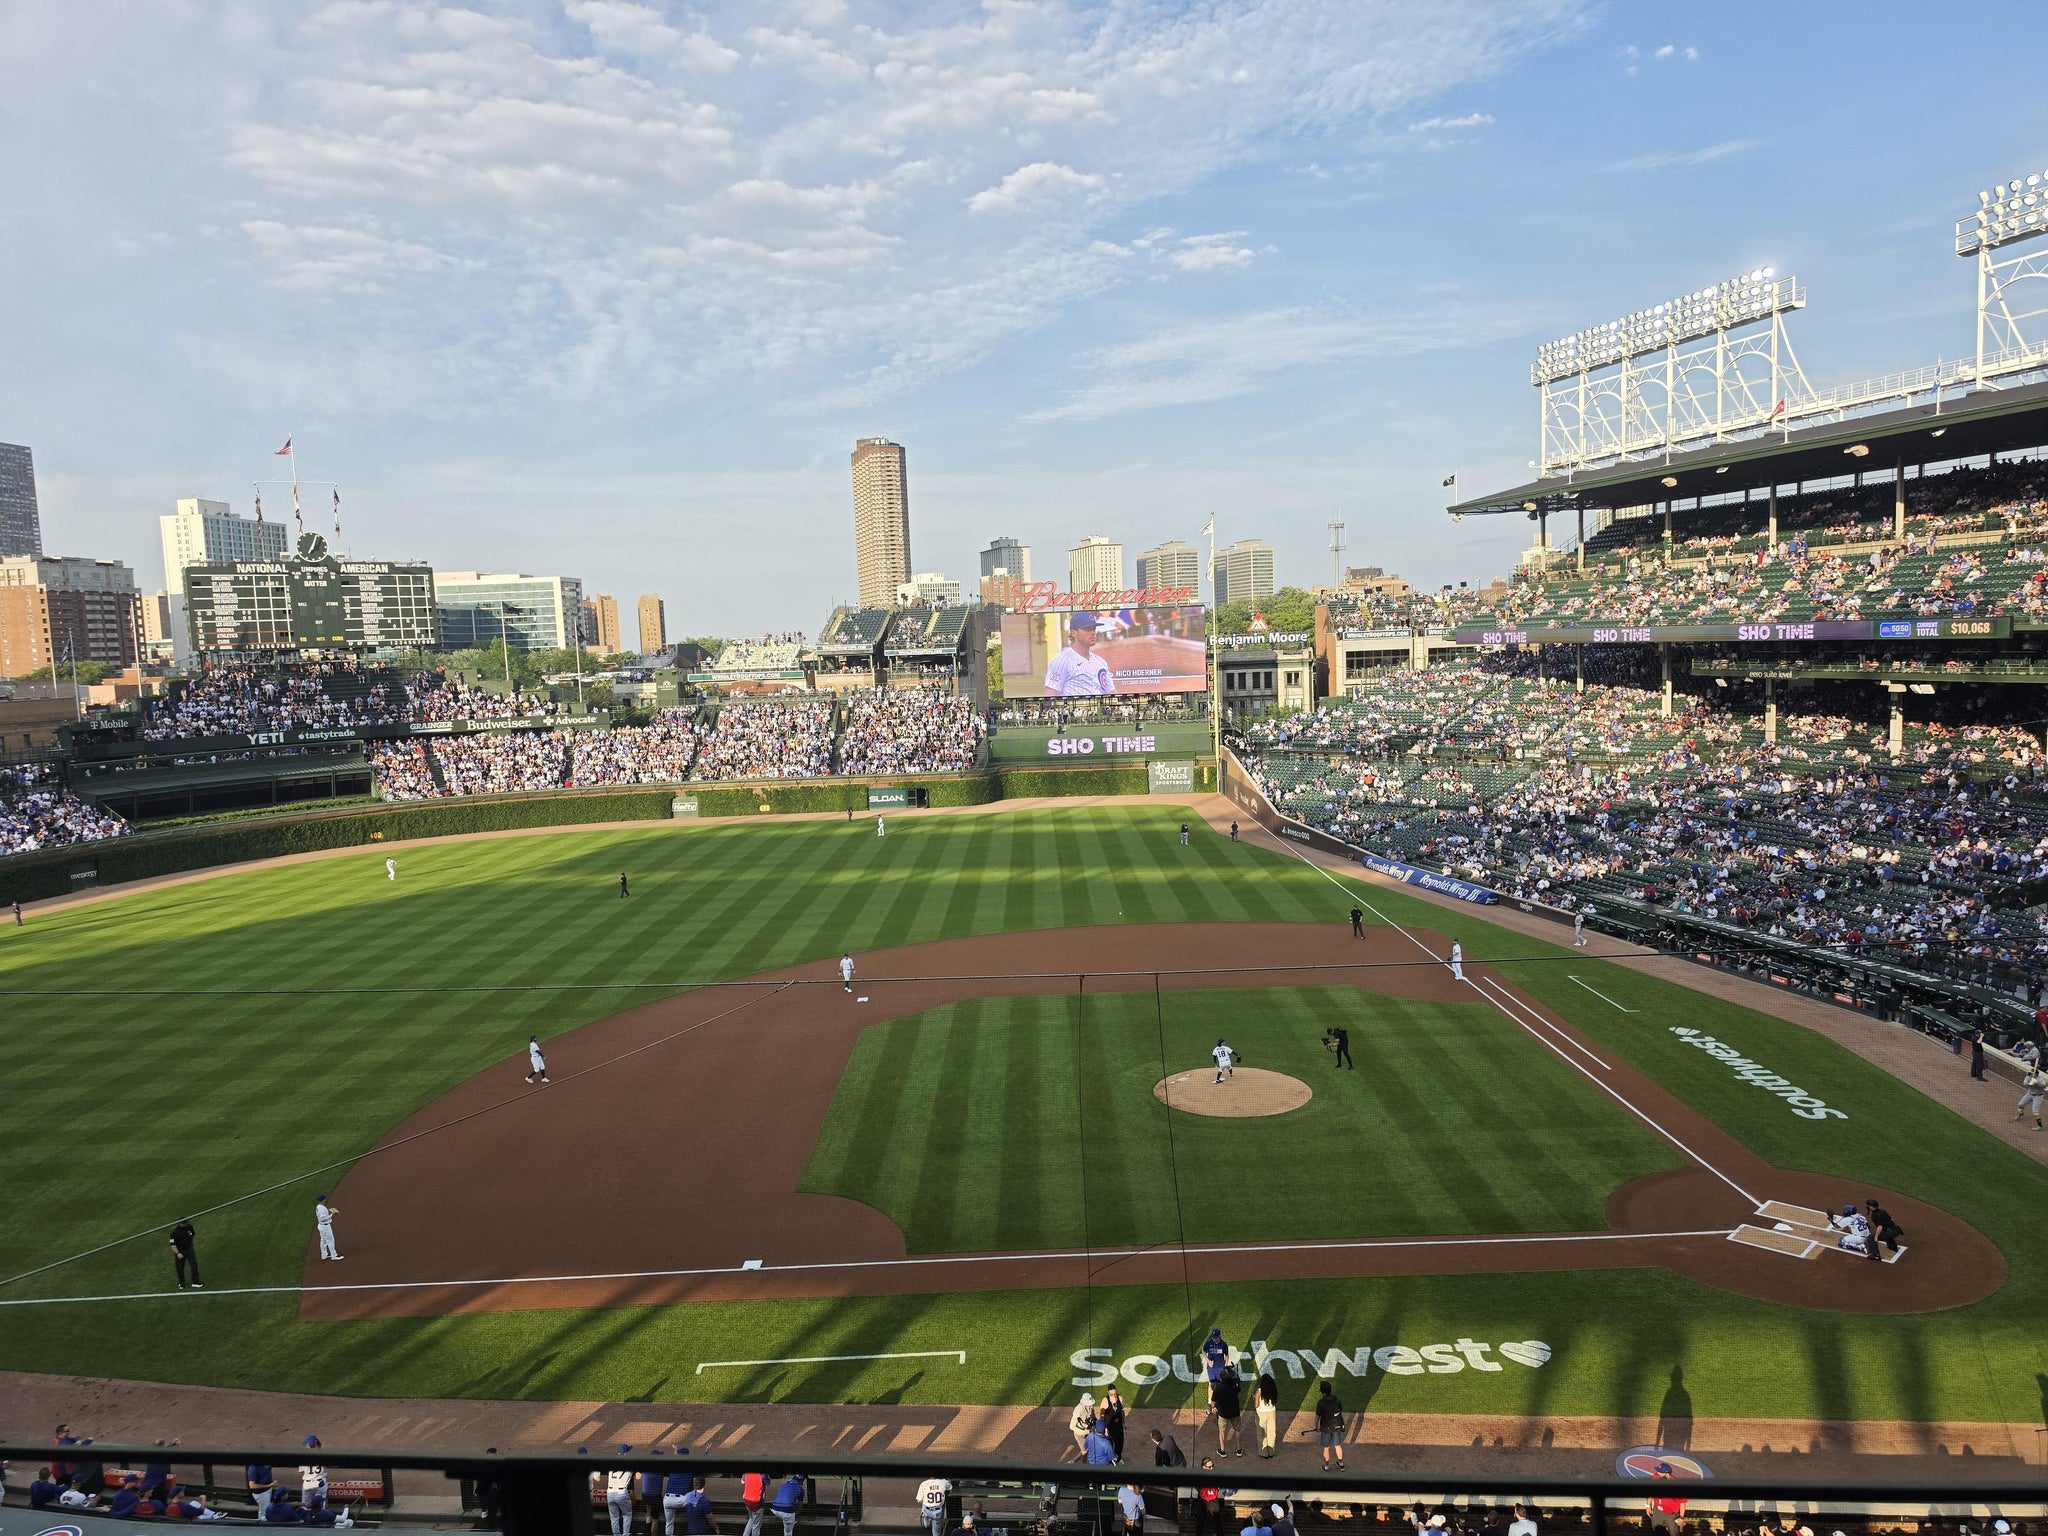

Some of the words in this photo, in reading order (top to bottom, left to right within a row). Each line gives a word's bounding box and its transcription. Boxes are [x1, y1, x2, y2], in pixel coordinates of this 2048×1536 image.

[236, 564, 288, 573] NATIONAL
[340, 564, 388, 573] AMERICAN
[1011, 580, 1194, 612] Budweiser
[1738, 625, 1770, 640] SHO
[1776, 624, 1814, 640] TIME
[1951, 622, 1990, 635] $10,068
[1209, 634, 1265, 647] Benjamin
[1269, 632, 1308, 642] Moore
[1483, 632, 1501, 643] SHO
[1505, 632, 1527, 643] TIME
[1594, 629, 1617, 642] SHO
[1622, 629, 1650, 641] TIME
[100, 720, 128, 729] Mobile
[410, 722, 452, 730] GRAINGER
[556, 716, 596, 725] Advocate
[247, 732, 284, 745] YETI
[305, 729, 356, 739] tastytrade
[1047, 738, 1095, 755] SHO
[1102, 736, 1155, 753] TIME
[1156, 766, 1189, 775] DRAFT
[1367, 859, 1390, 874] Reynolds
[1388, 866, 1404, 881] Wrap
[1419, 875, 1450, 891] Reynolds
[1450, 881, 1468, 897] Wrap
[1679, 1036, 1848, 1119] Southwest
[1070, 1338, 1502, 1387] Southwest
[927, 1492, 942, 1503] 90
